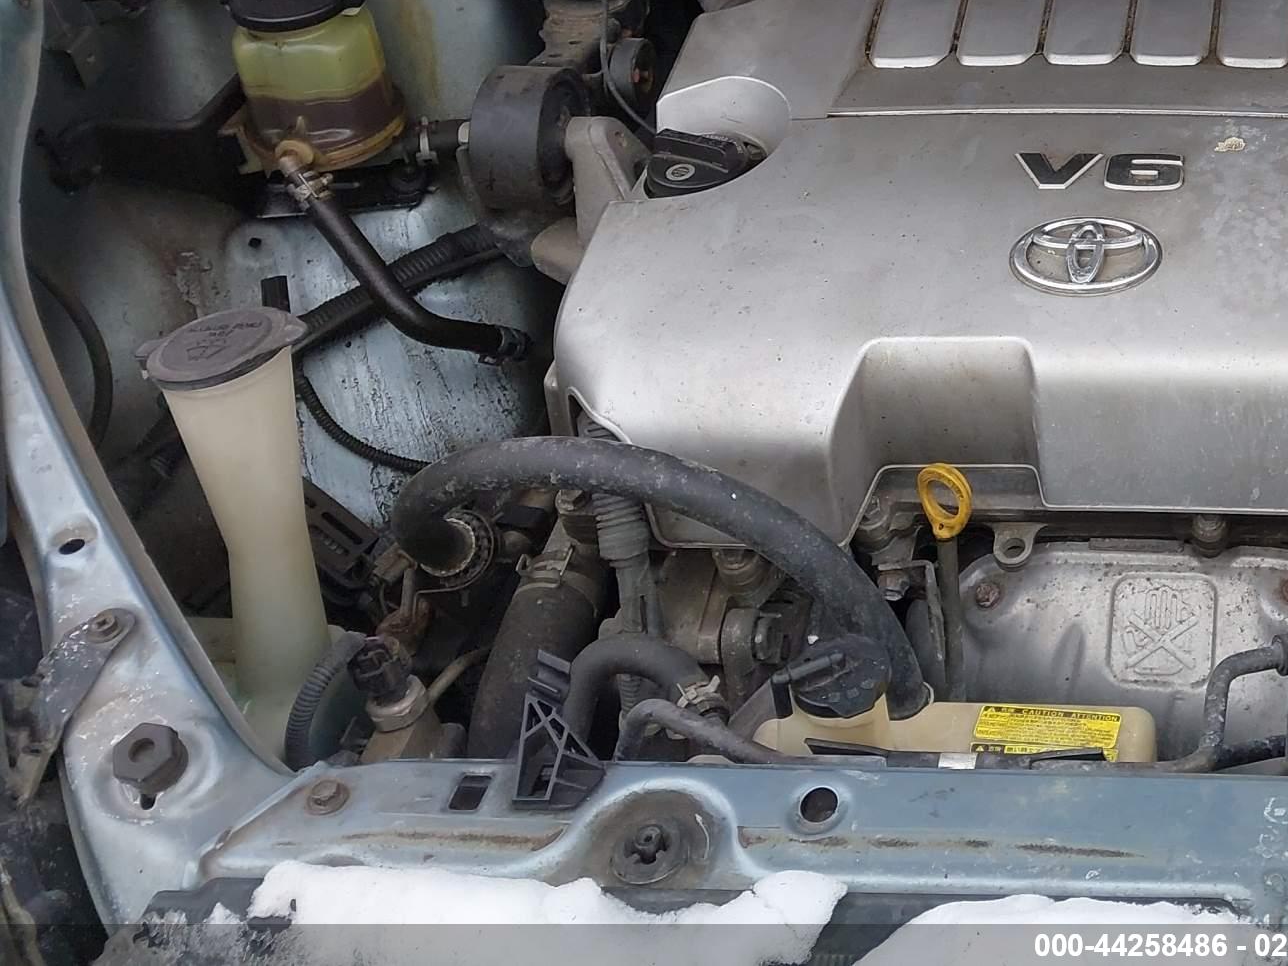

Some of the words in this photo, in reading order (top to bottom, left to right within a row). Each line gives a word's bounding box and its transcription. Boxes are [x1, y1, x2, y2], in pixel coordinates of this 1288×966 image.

[1014, 151, 1185, 192] V6
[1022, 708, 1065, 718] CAUTION
[1071, 713, 1118, 722] ATTENTION
